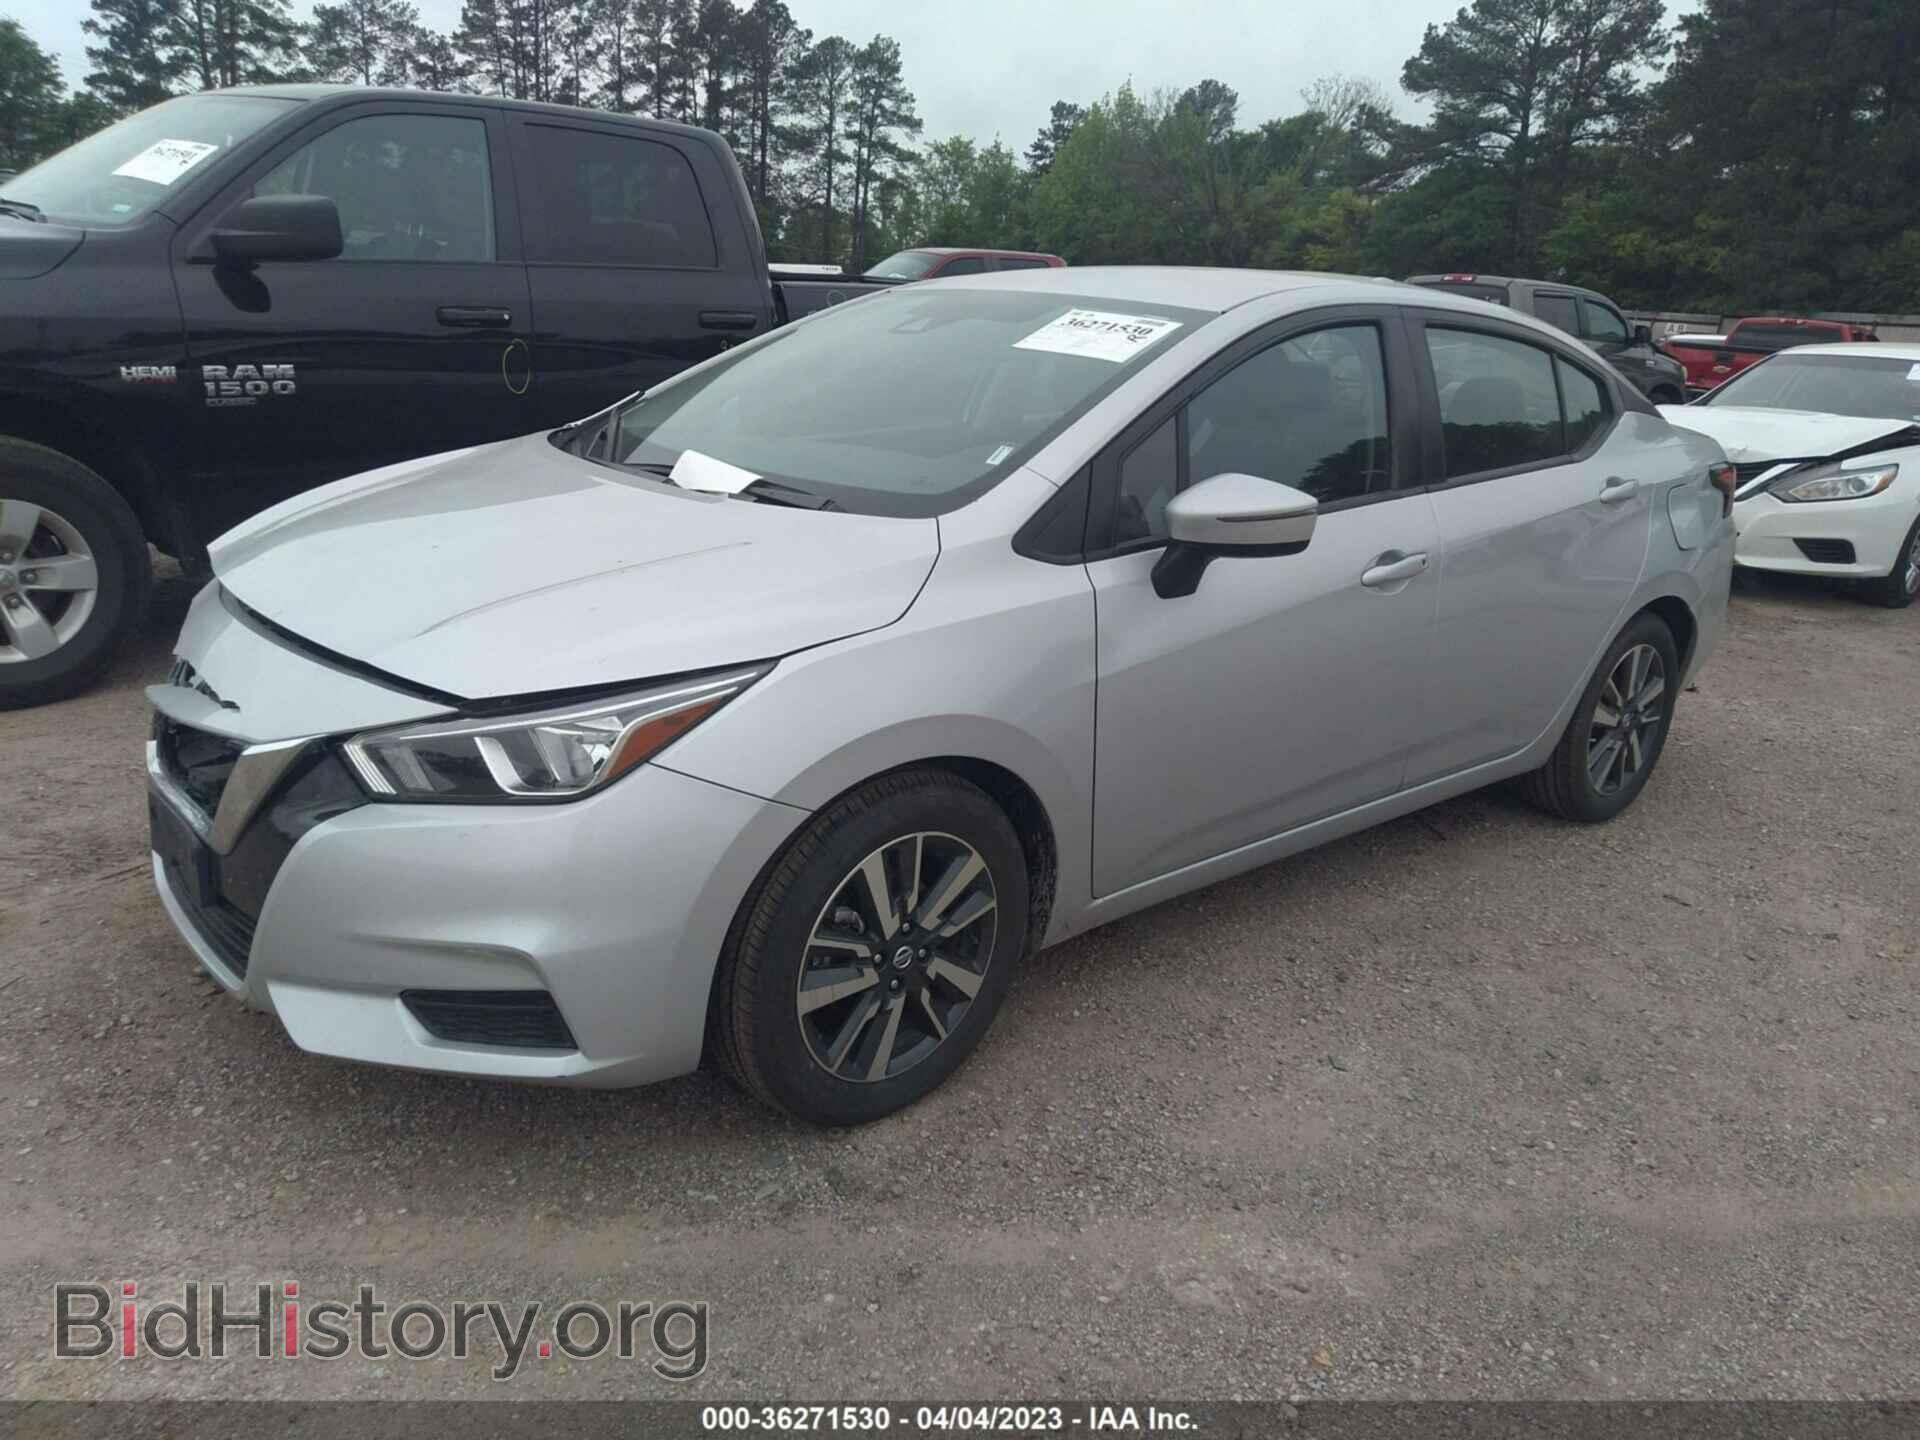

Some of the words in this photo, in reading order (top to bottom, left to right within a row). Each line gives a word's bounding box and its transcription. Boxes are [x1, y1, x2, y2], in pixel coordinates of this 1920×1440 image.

[1061, 318, 1153, 335] 36271530
[120, 366, 177, 377] HEMI
[202, 364, 296, 379] RAM
[204, 380, 296, 396] 1500
